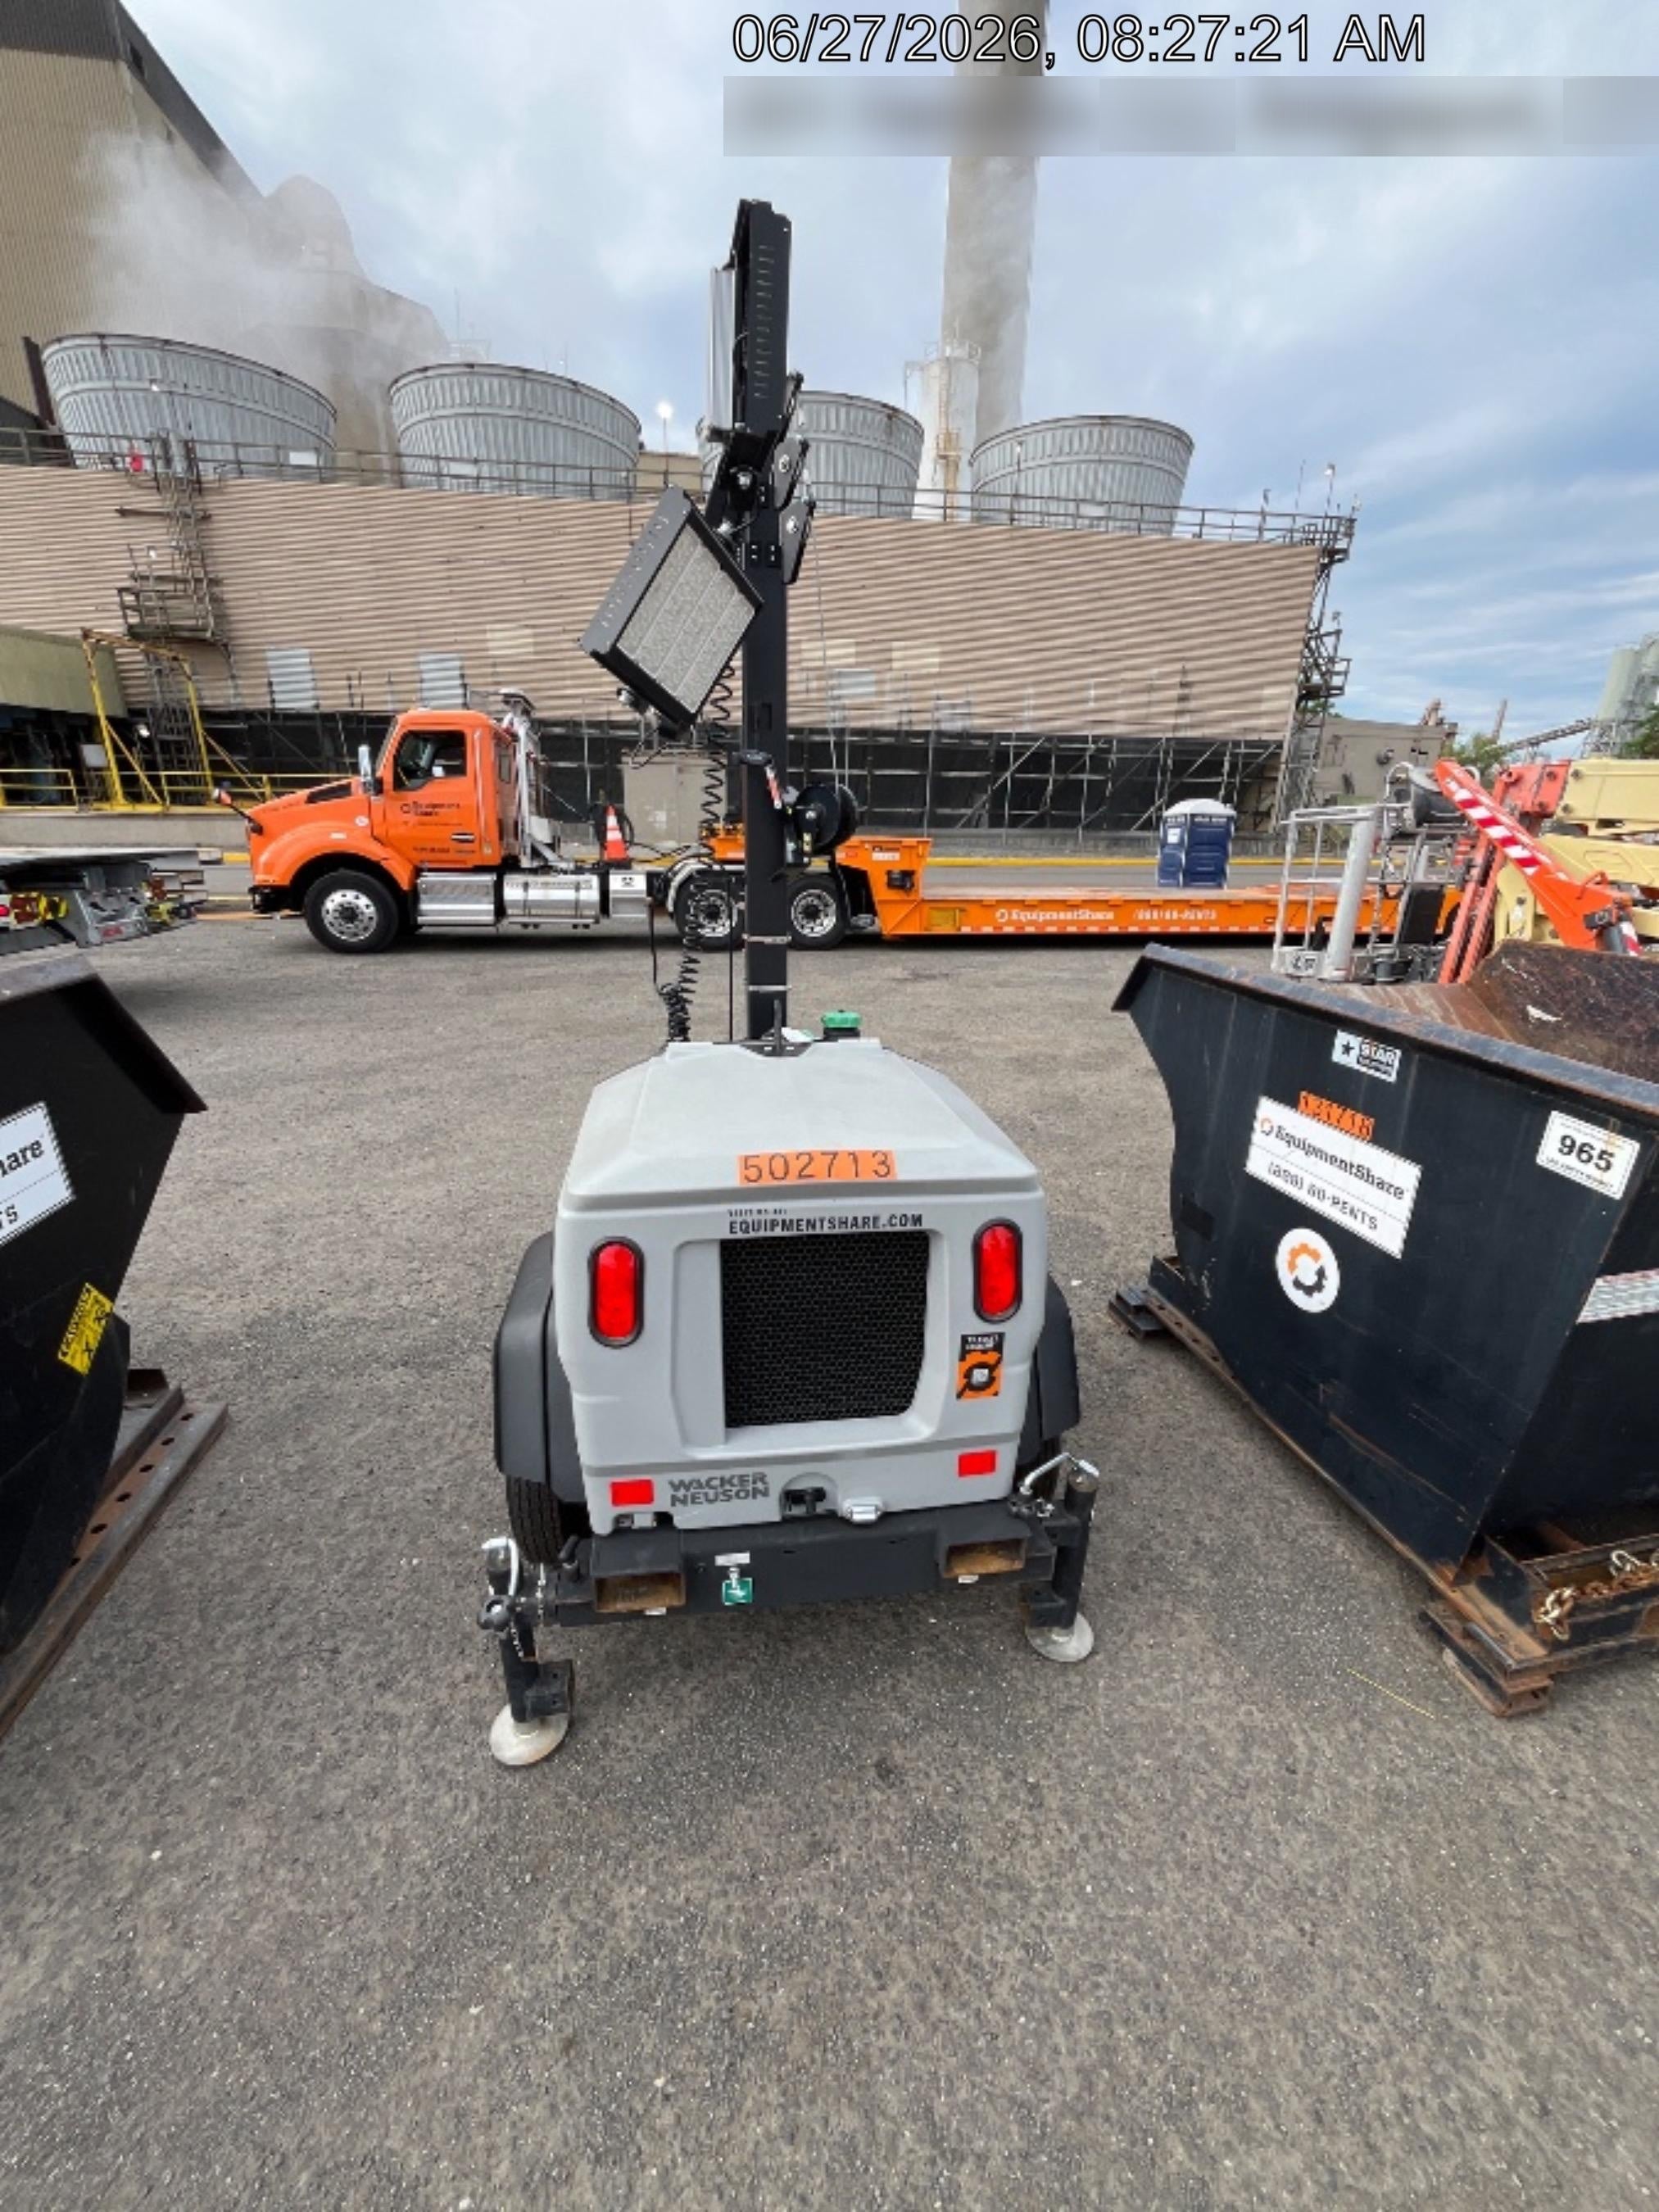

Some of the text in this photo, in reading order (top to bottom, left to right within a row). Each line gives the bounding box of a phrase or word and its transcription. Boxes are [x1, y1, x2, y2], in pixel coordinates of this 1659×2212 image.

[743, 1149, 891, 1183] 502713
[1275, 1125, 1405, 1200] EquipmentShare
[1558, 1135, 1615, 1172] 965
[729, 1213, 923, 1235] EQUIPMENTSHARE.COM
[669, 1472, 768, 1492] WACKER
[671, 1486, 769, 1507] NEUSON
